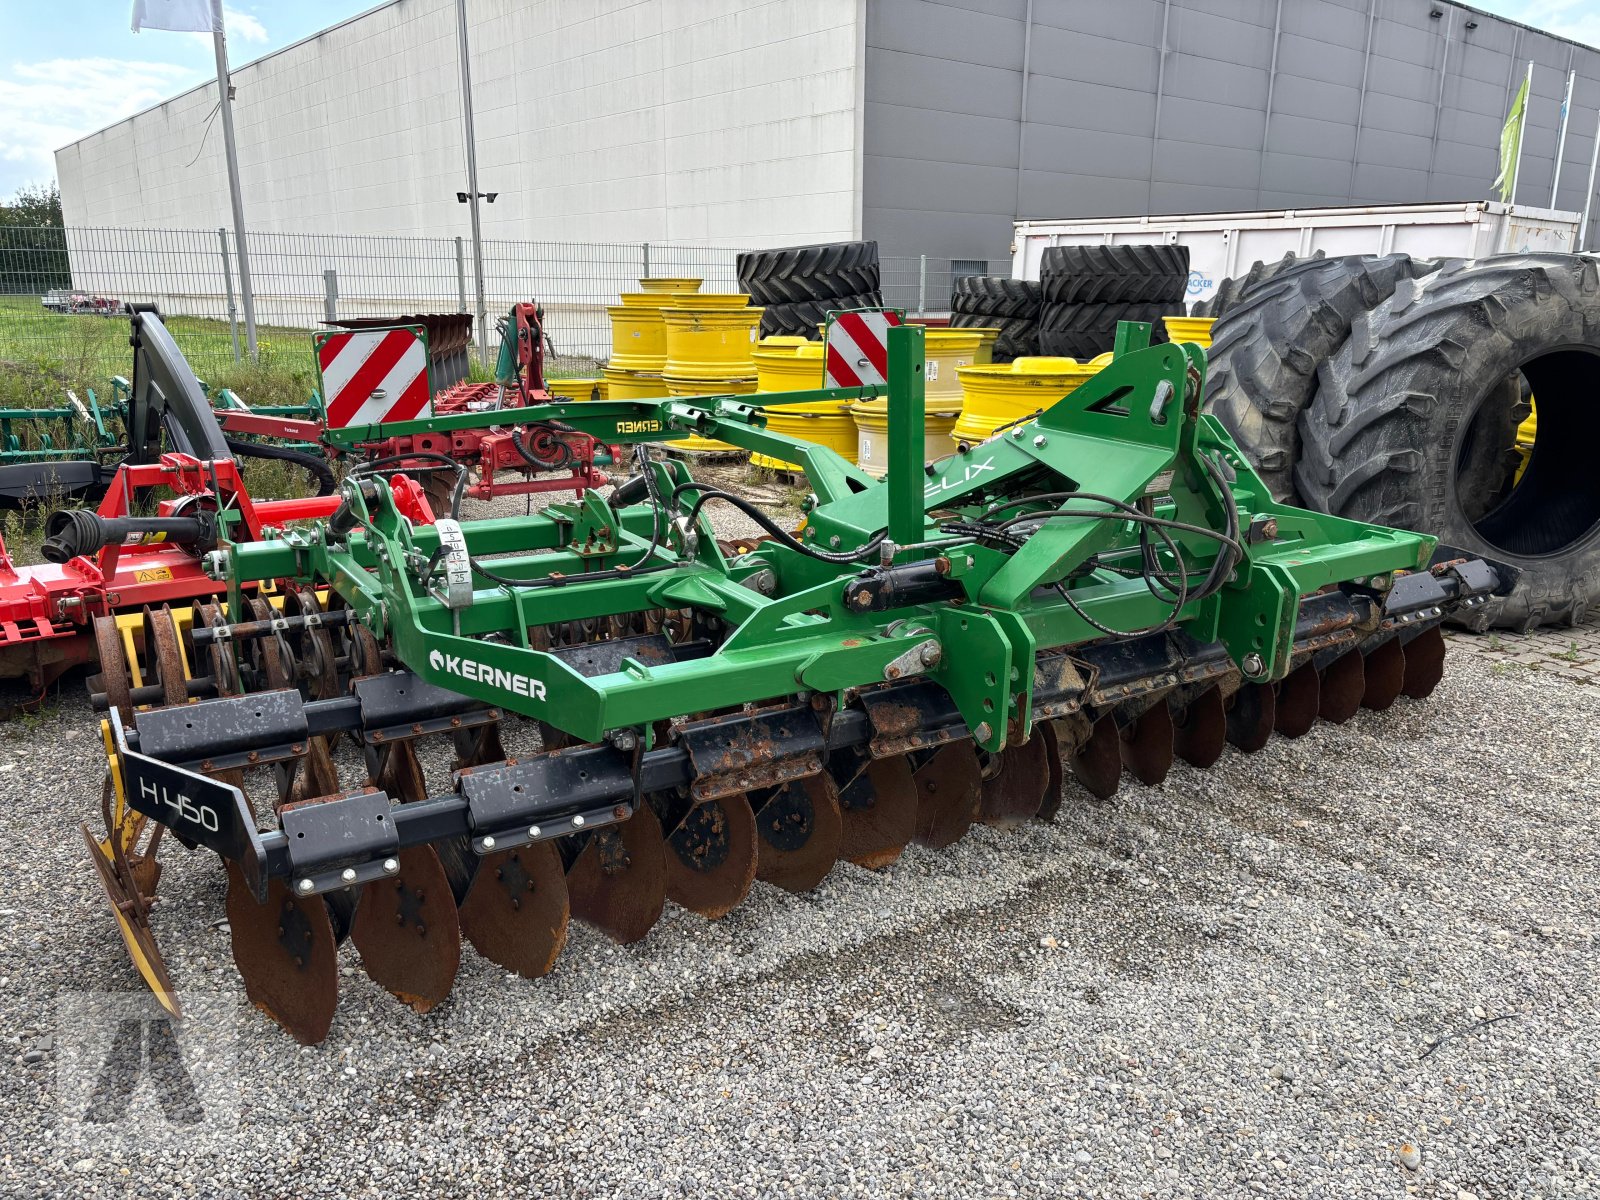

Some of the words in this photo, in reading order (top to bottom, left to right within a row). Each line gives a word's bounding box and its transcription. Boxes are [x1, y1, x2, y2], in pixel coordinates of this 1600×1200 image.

[449, 533, 455, 541] 5
[452, 552, 462, 560] 15
[454, 574, 465, 583] 25
[445, 653, 547, 703] KERNER
[139, 776, 159, 805] H
[162, 786, 219, 832] 450
